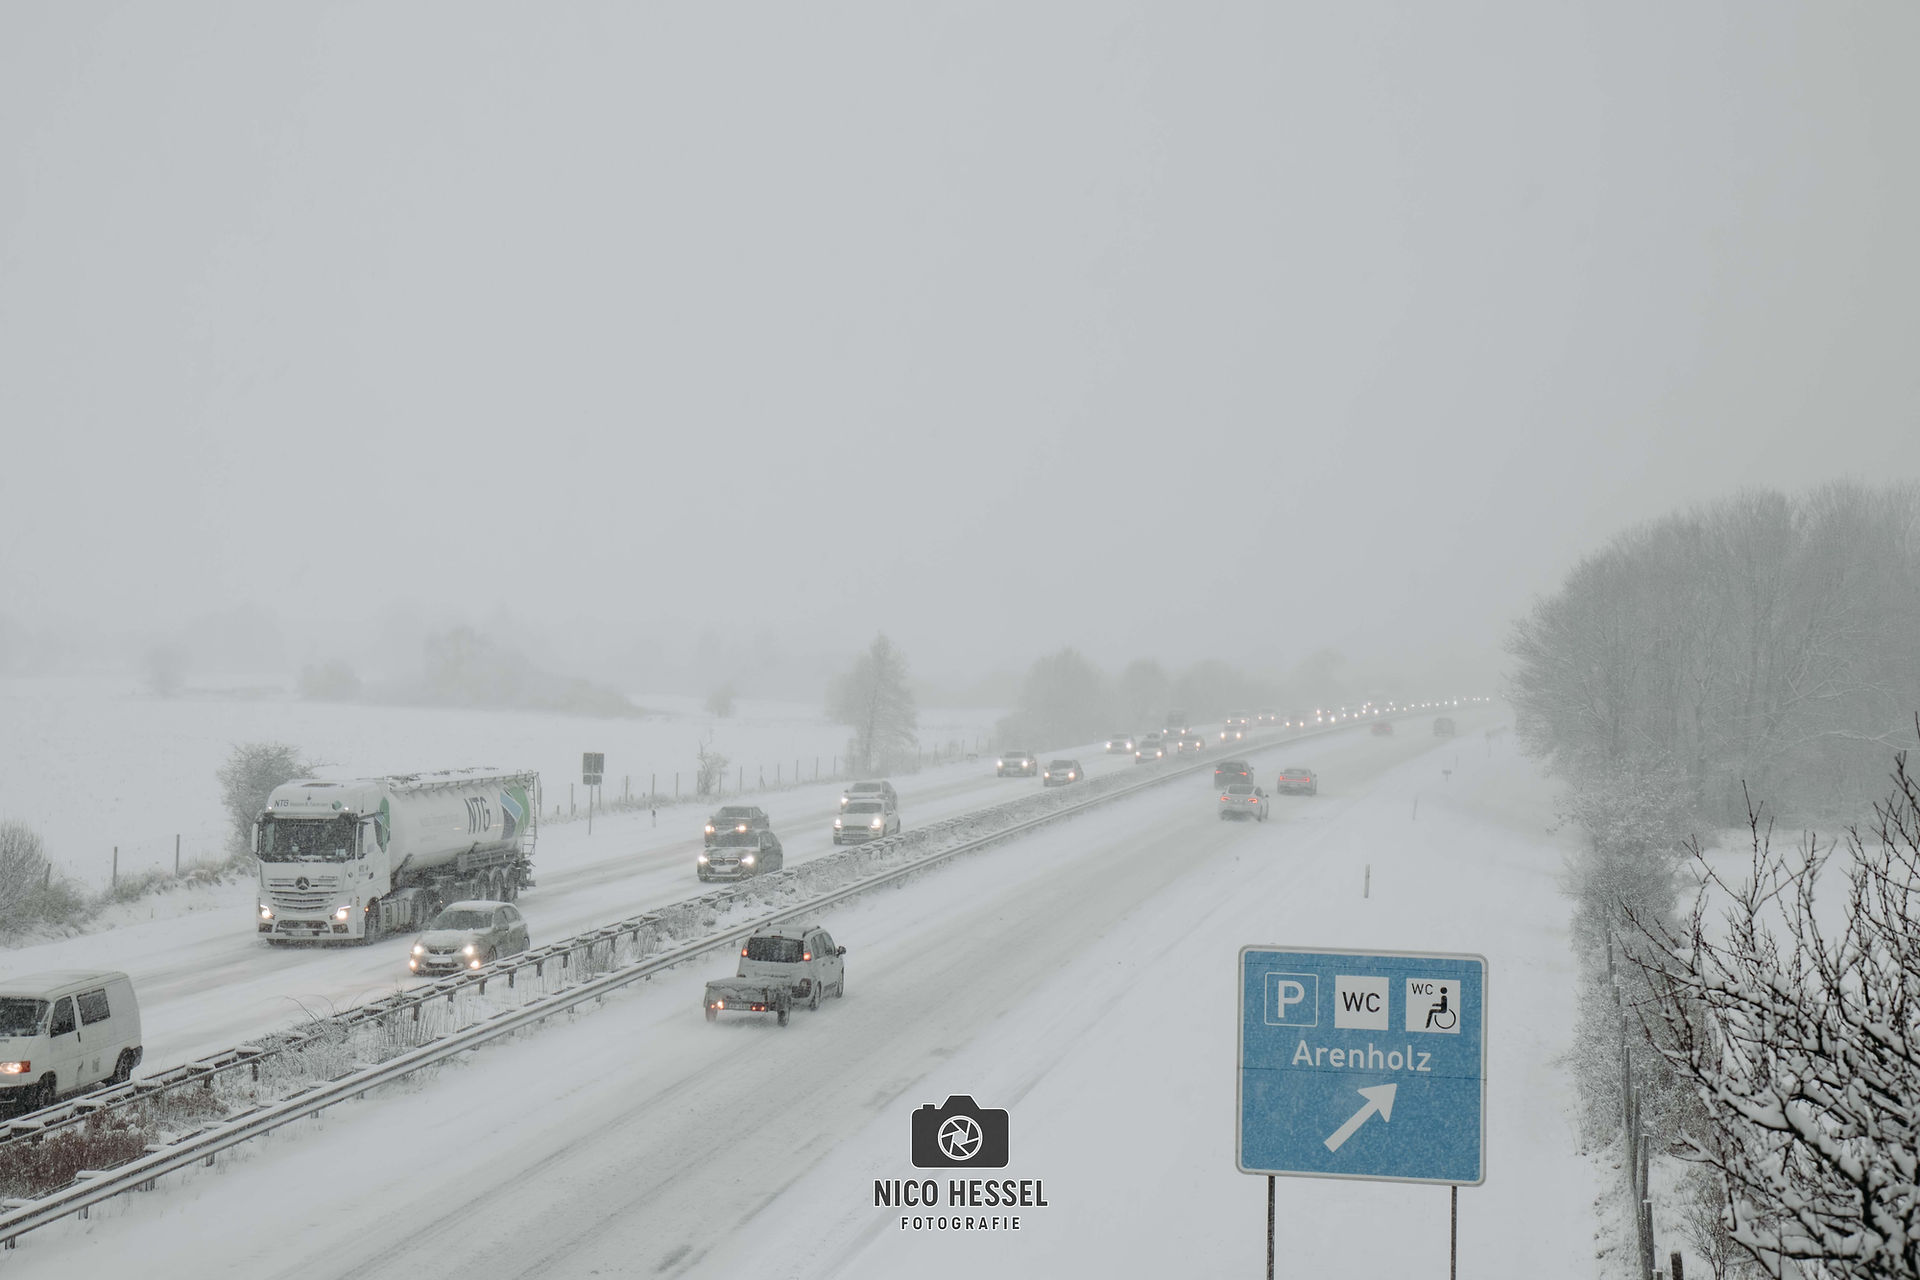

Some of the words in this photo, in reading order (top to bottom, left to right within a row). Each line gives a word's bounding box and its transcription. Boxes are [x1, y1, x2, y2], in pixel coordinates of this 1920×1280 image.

[274, 799, 289, 808] NTG
[464, 796, 491, 834] NTG
[1277, 980, 1305, 1018] P
[1342, 991, 1381, 1013] WC
[1411, 982, 1434, 996] WC
[1291, 1039, 1432, 1073] Arenholz
